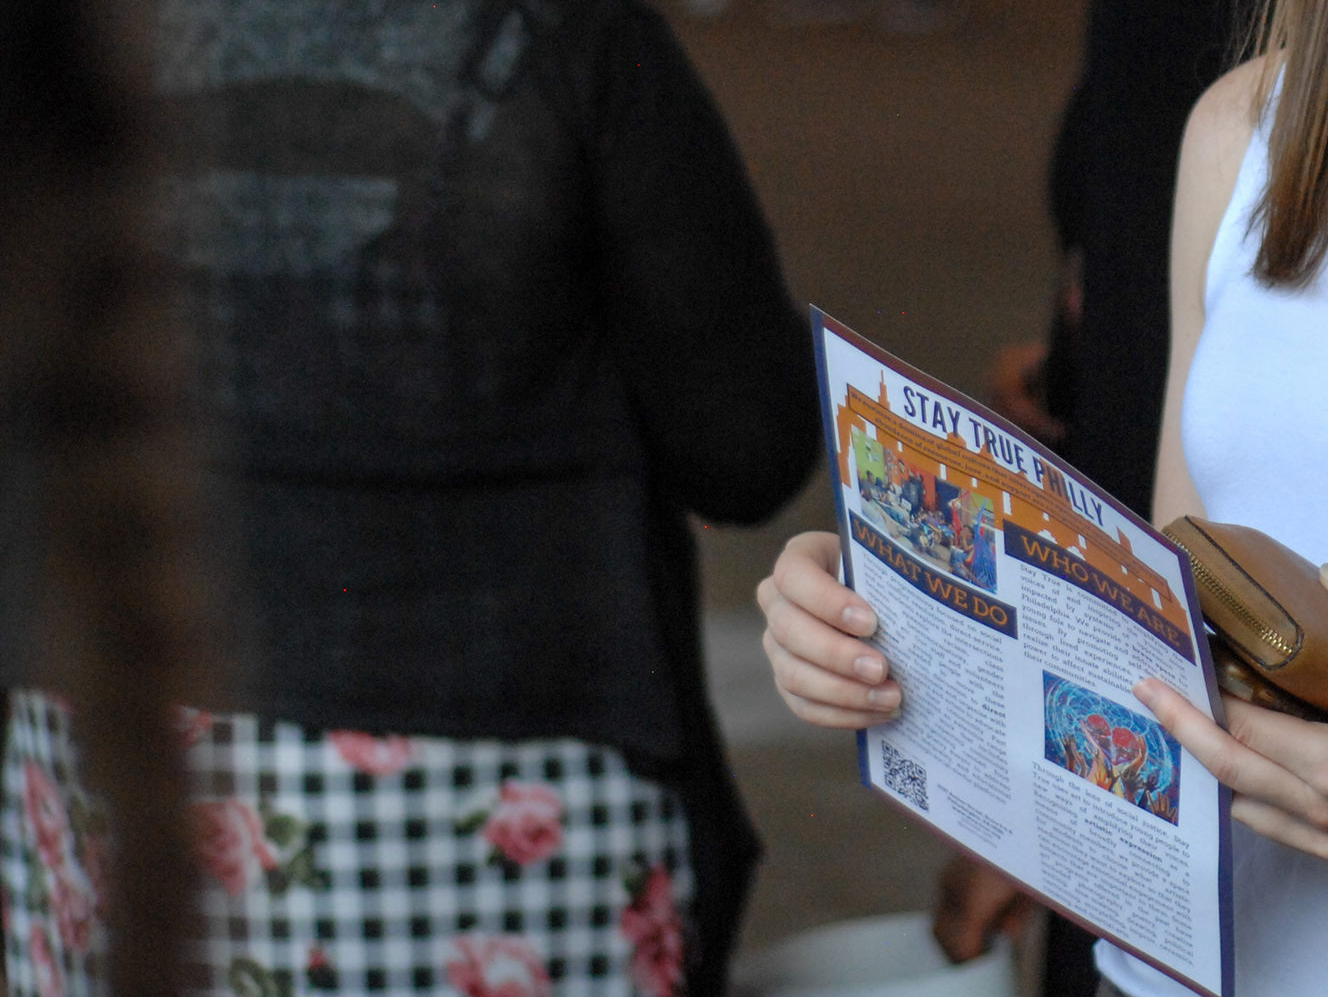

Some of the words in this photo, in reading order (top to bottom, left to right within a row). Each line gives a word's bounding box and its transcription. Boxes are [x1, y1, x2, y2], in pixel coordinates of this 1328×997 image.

[903, 386, 960, 438] STAY
[969, 417, 1025, 473] TRUE
[1034, 458, 1103, 526] PHILLY
[854, 520, 922, 578] WHAT
[926, 572, 968, 608] WE
[974, 595, 1007, 626] DO
[1020, 574, 1044, 589] voices
[1052, 588, 1059, 596] of
[1066, 594, 1080, 606] and
[1087, 603, 1120, 629] inspiring
[1126, 625, 1137, 638] the
[1021, 535, 1088, 583] WHO
[1093, 573, 1133, 612] WE
[1137, 607, 1180, 646] ARE
[1020, 563, 1036, 577] Stay
[1041, 572, 1060, 587] True
[1066, 583, 1072, 592] is
[1077, 591, 1117, 617] committed
[1121, 614, 1128, 625] to
[1172, 650, 1183, 665] the
[1021, 583, 1057, 603] impacted
[1066, 601, 1074, 613] by
[1084, 611, 1114, 632] systems
[1122, 632, 1129, 640] of
[1021, 592, 1070, 619] Philadelphia.
[1075, 615, 1089, 627] We
[1093, 625, 1121, 644] provide
[1132, 644, 1152, 662] brave
[1155, 660, 1175, 679] space
[1022, 611, 1046, 628] issues.
[1058, 627, 1066, 638] By
[1077, 637, 1118, 661] promoting
[1022, 604, 1046, 620] young
[1049, 614, 1063, 626] folx
[1067, 621, 1075, 631] to
[1079, 628, 1110, 647] navigate
[1114, 644, 1128, 656] and
[1131, 654, 1157, 674] address
[1022, 621, 1053, 641] through
[1060, 637, 1078, 651] lived
[1084, 649, 1132, 678] experiences,
[1023, 632, 1048, 647] realize
[1052, 643, 1070, 657] their
[1074, 653, 1099, 670] innate
[1102, 667, 1134, 686] abilities
[1023, 643, 1046, 656] power
[1051, 652, 1058, 662] to
[1062, 659, 1084, 672] affect
[1088, 670, 1132, 695] sustainable
[1024, 650, 1042, 664] their
[1044, 660, 1096, 688] communities.
[981, 701, 1005, 719] direct
[1033, 761, 1063, 784] Through
[1068, 780, 1080, 792] the
[1085, 789, 1100, 803] lens
[1105, 801, 1112, 809] of
[1117, 807, 1137, 822] social
[1142, 818, 1168, 839] justice,
[1173, 834, 1189, 850] Stay
[1033, 770, 1049, 785] True
[1052, 782, 1068, 795] uses
[1070, 791, 1080, 801] art
[1083, 796, 1090, 806] to
[1092, 801, 1128, 826] introduce
[1130, 823, 1153, 841] young
[1155, 836, 1179, 853] people
[1182, 849, 1189, 859] to
